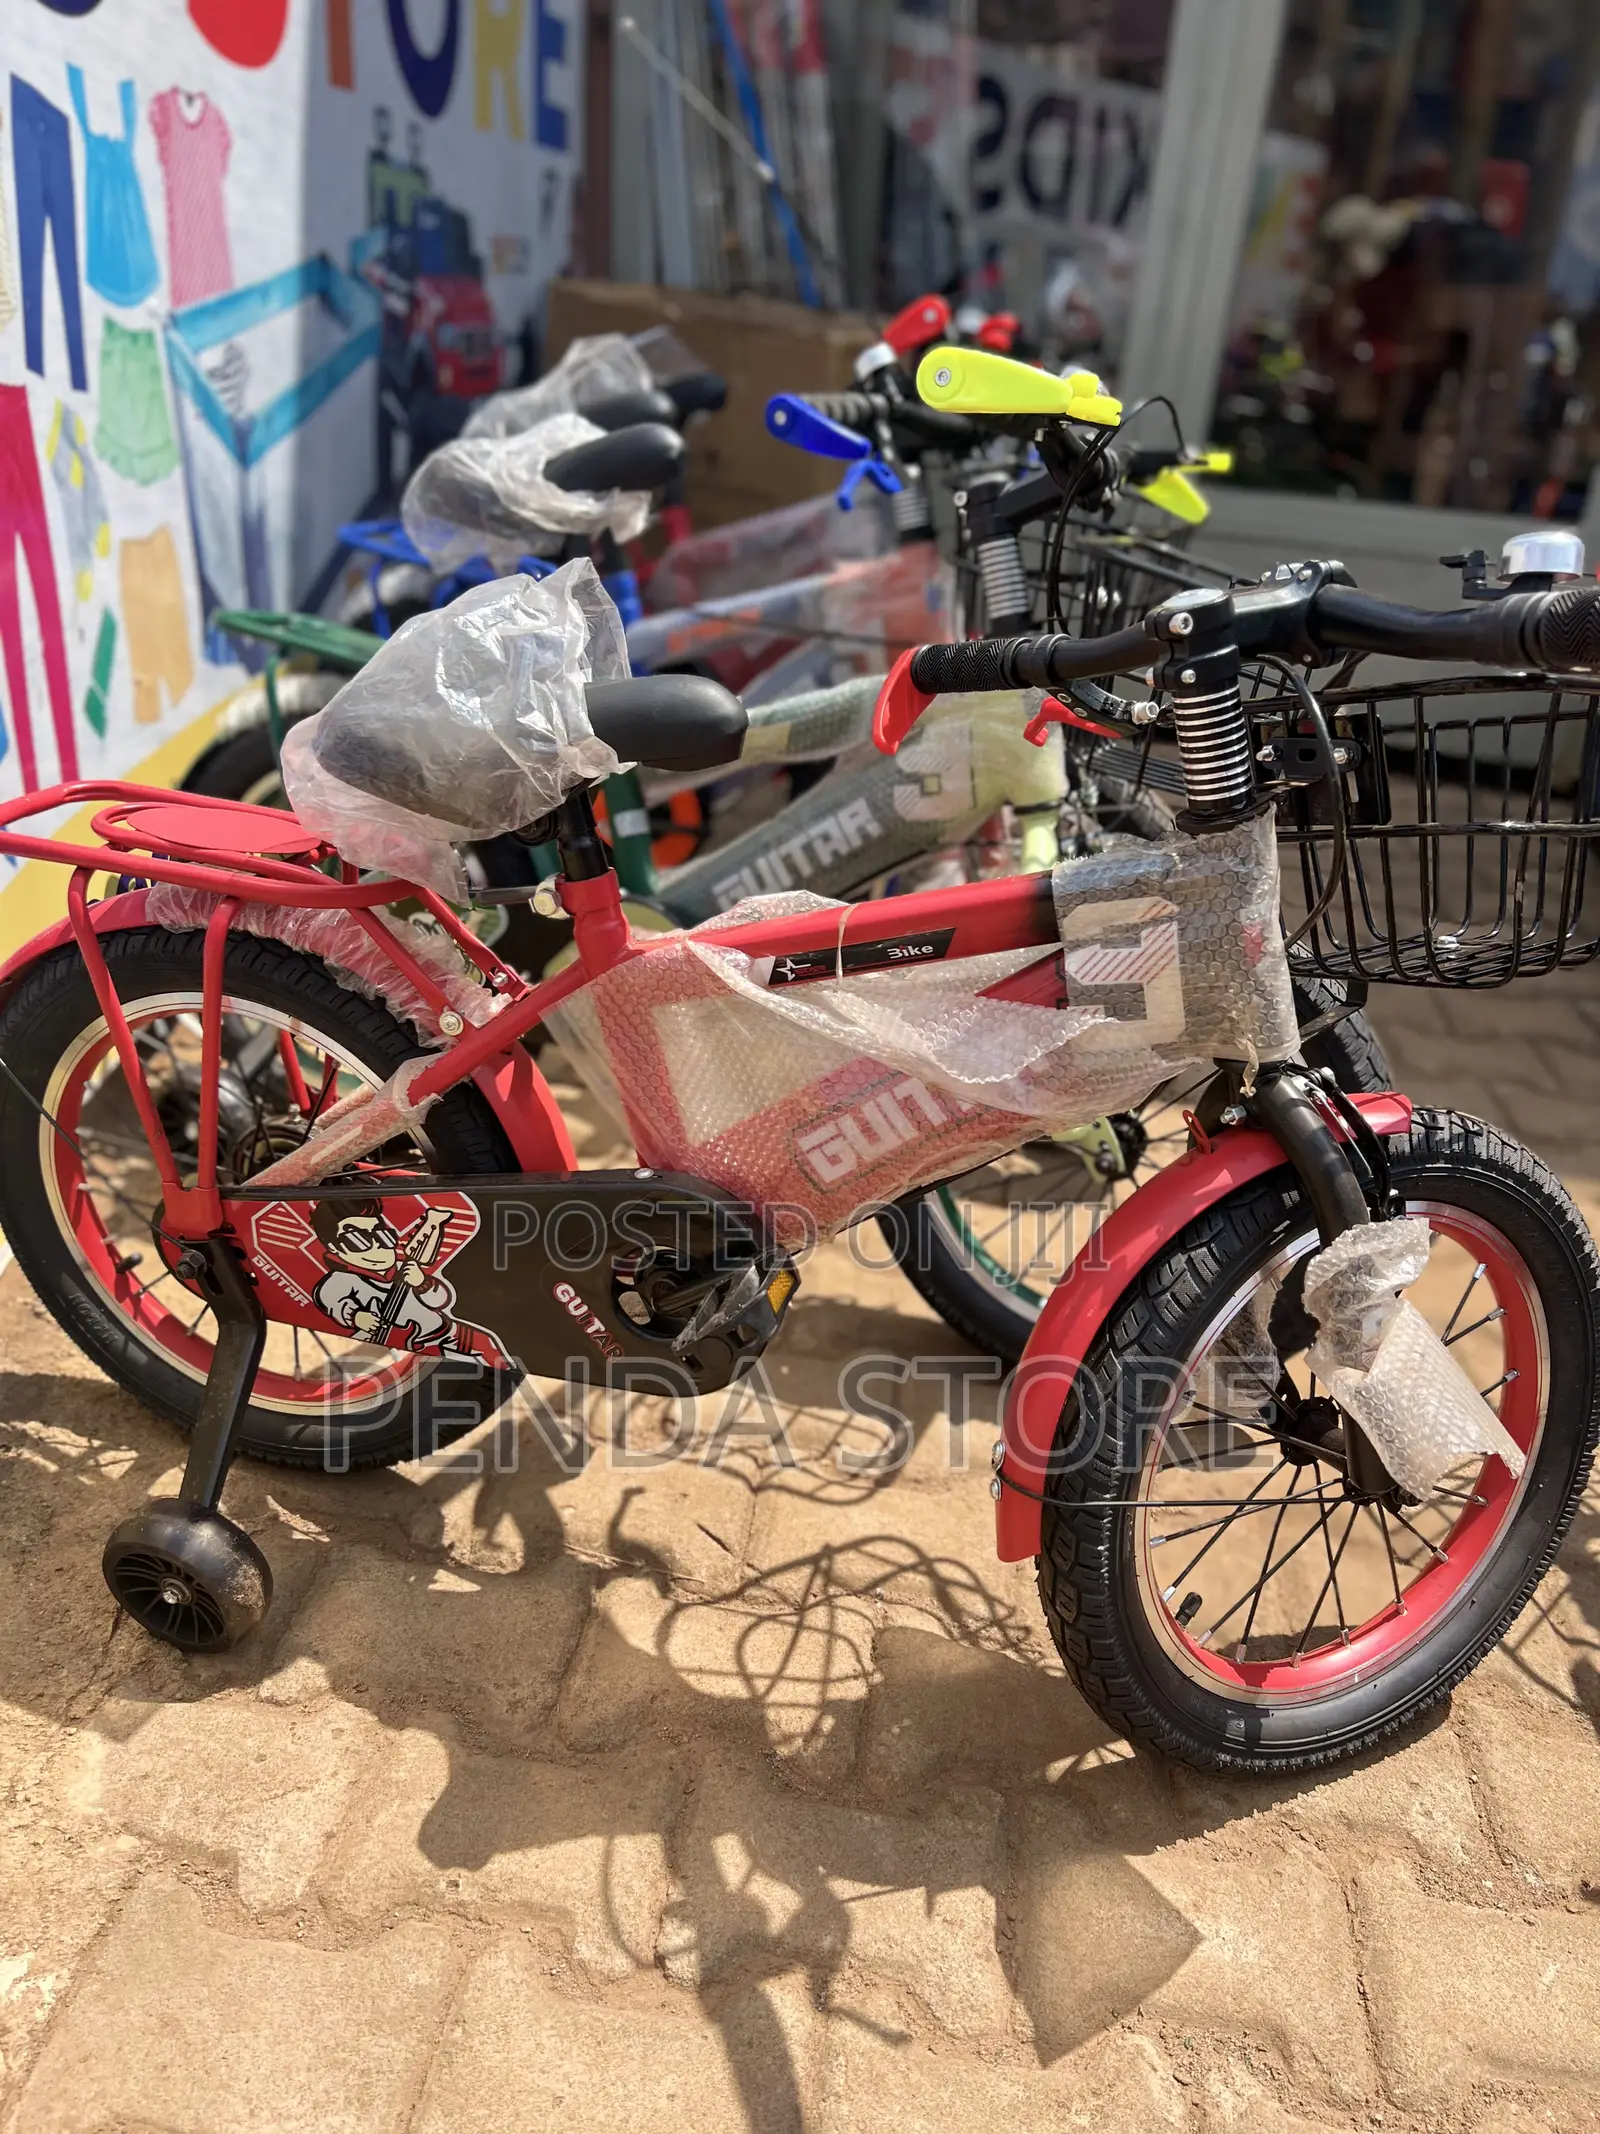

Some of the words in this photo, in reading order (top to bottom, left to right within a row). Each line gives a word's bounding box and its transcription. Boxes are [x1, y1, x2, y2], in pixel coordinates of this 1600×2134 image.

[886, 944, 934, 960] Bike
[251, 1254, 310, 1308] GUITAR
[553, 1282, 625, 1363] GUITAR
